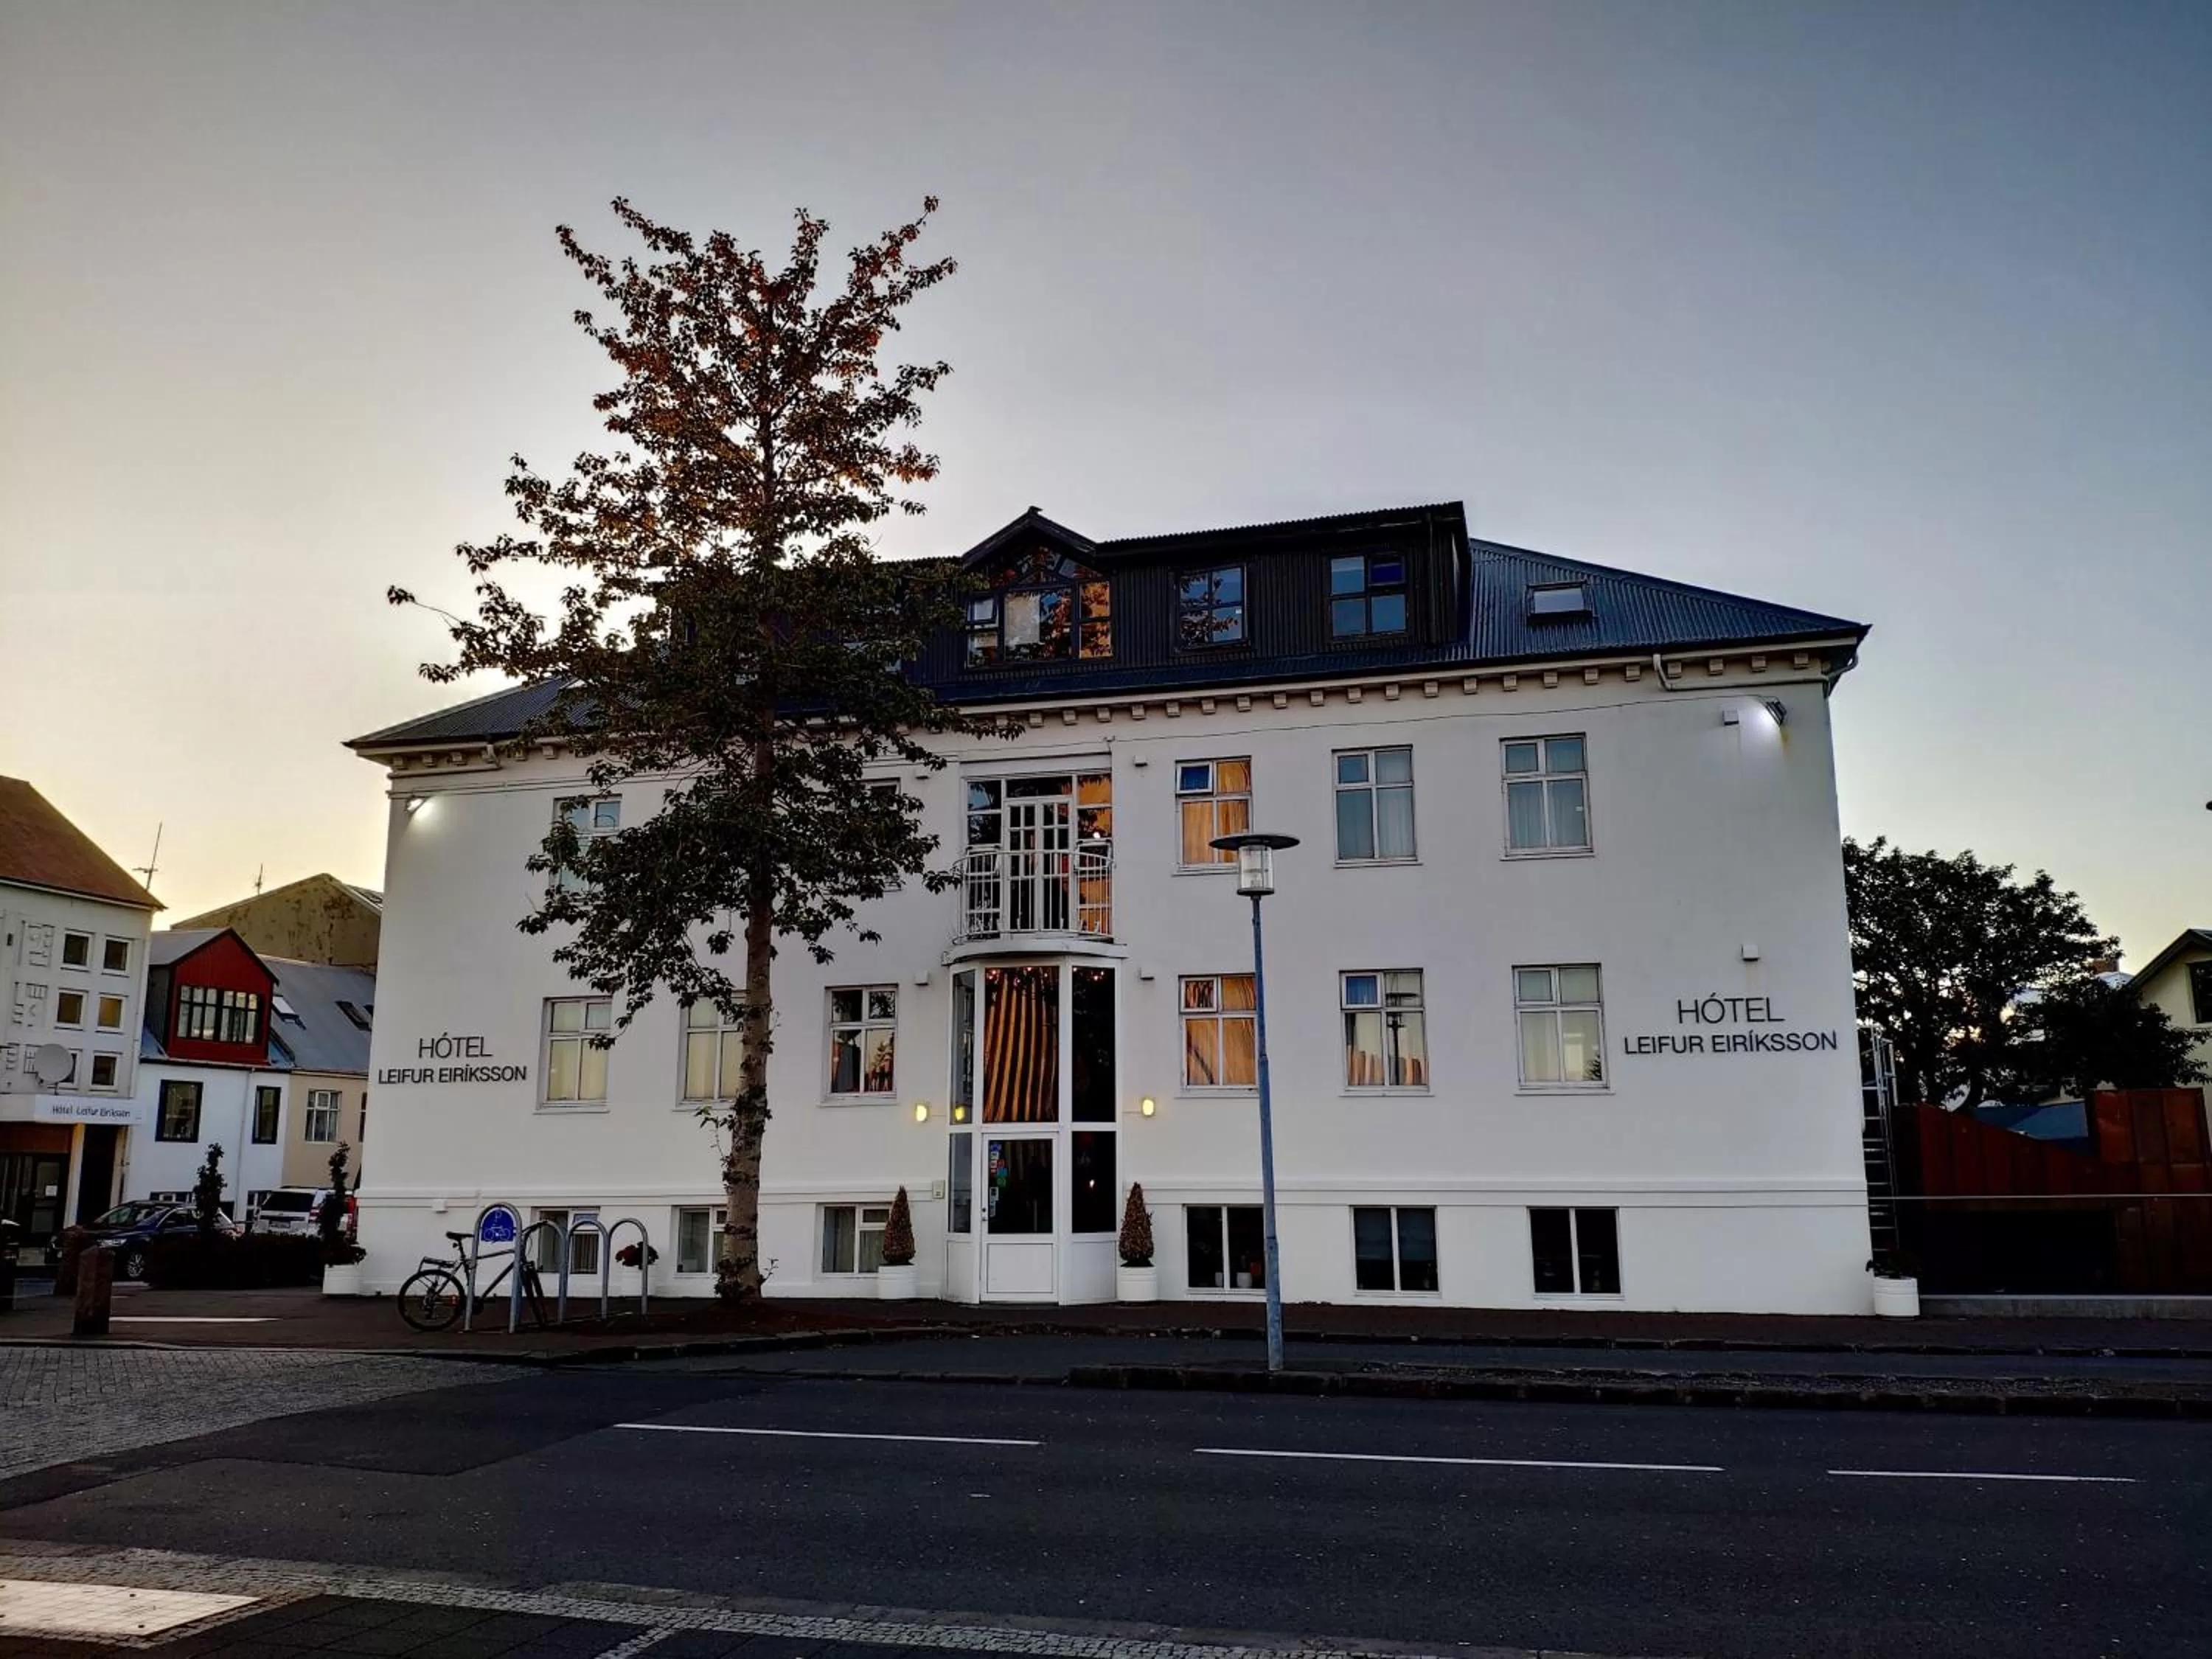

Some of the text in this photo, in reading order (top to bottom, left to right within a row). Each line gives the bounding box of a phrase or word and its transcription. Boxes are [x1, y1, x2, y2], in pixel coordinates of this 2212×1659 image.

[1677, 992, 1786, 1024] HÓTEL
[418, 1032, 493, 1058] HÓTEL
[1624, 1029, 1838, 1054] LEIFUR EIRÍKSSON
[378, 1064, 528, 1084] LEIFUR EIRÍKSSON
